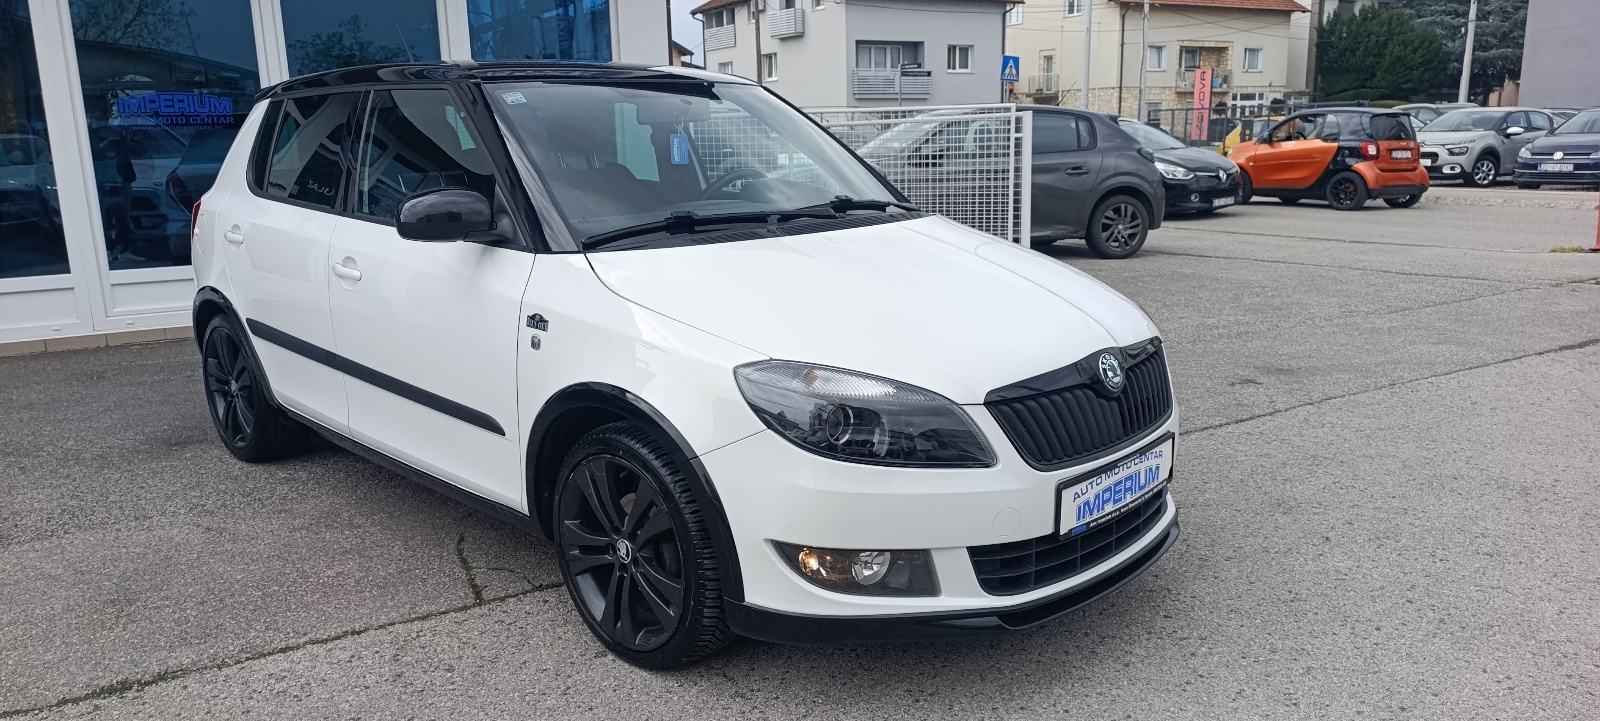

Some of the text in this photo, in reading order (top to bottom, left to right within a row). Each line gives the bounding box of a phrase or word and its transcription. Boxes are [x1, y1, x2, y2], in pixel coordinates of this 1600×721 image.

[117, 93, 231, 114] IMPERIUM
[190, 116, 234, 124] CENTAR
[1073, 450, 1163, 502] AUTO MOTO CENTAR
[1076, 464, 1160, 524] IMPERIUM
